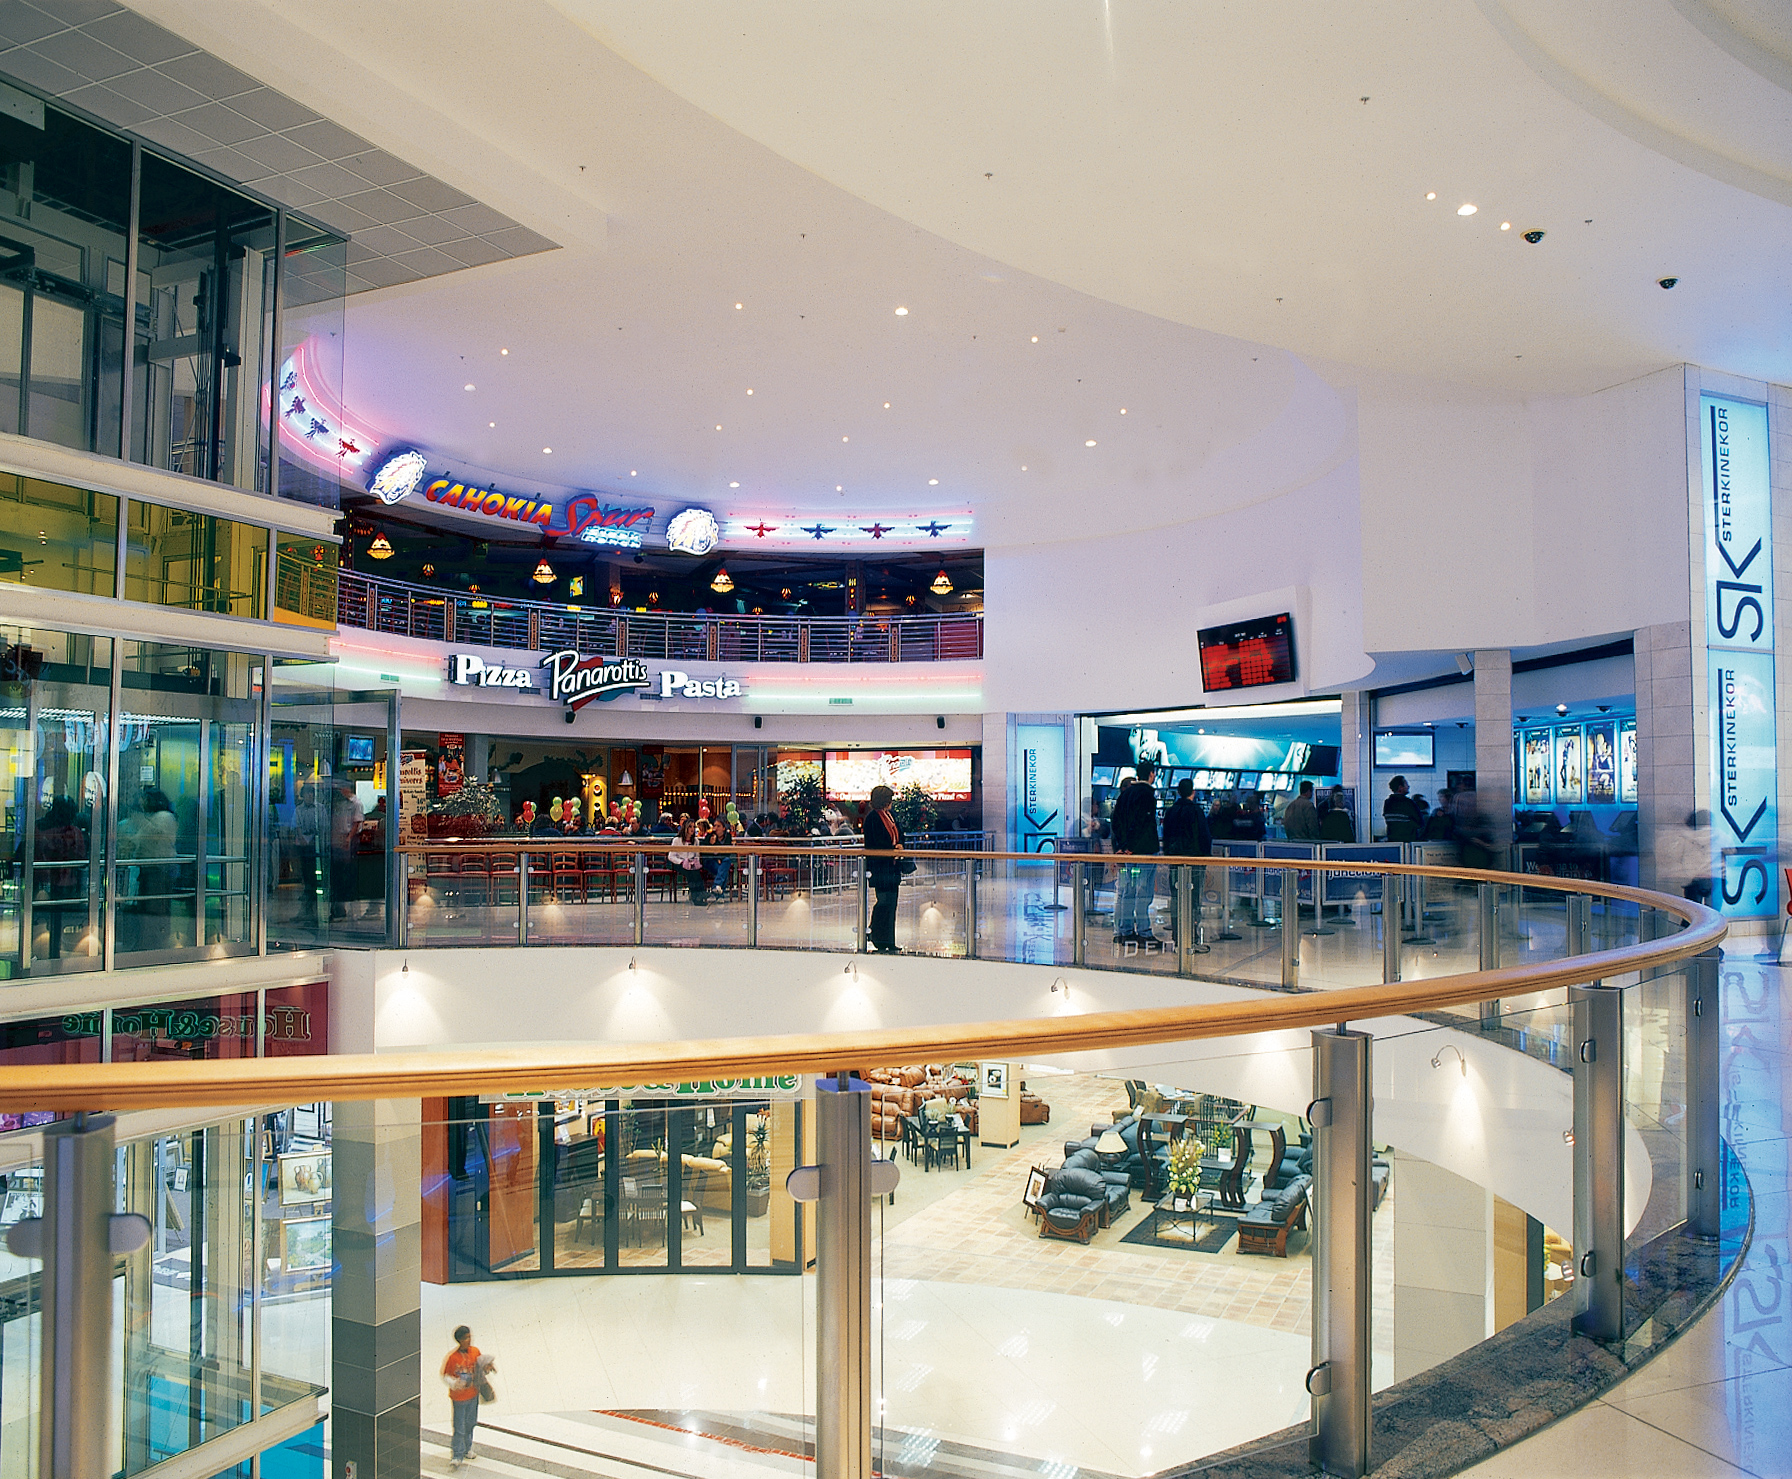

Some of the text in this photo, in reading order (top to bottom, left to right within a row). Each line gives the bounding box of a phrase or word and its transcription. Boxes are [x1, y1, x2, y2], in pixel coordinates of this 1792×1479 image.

[1718, 407, 1732, 542] STERKINEKOR
[424, 477, 656, 537] CAHOKIA Spur
[453, 654, 533, 688] Pizza
[542, 650, 648, 700] Panarottis
[659, 670, 743, 699] Pasta
[1725, 669, 1737, 806] STERKINEKOR
[1028, 748, 1037, 814] STERKINEKOR
